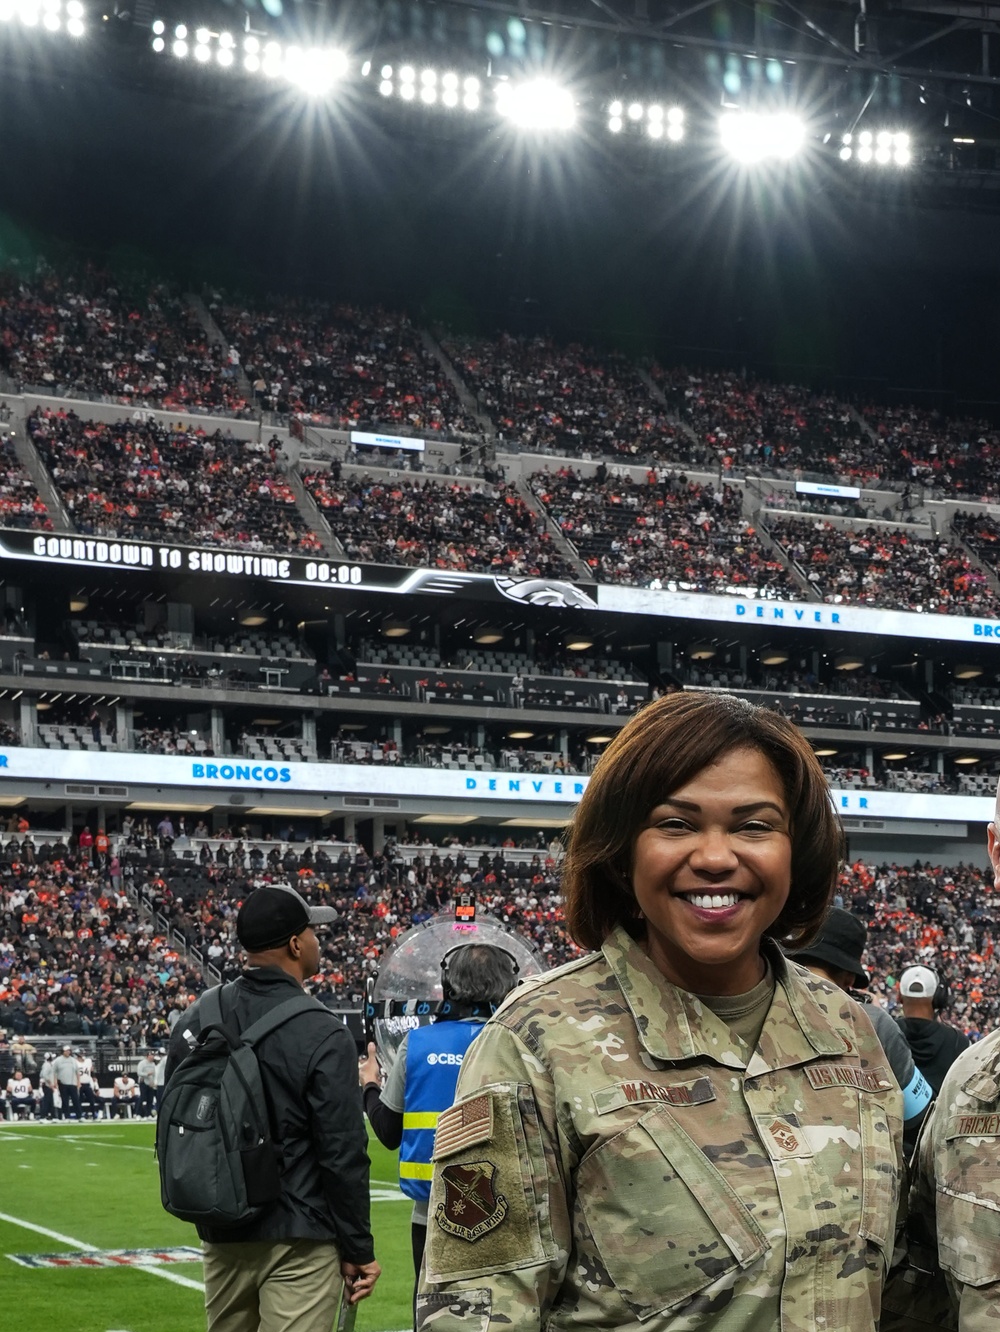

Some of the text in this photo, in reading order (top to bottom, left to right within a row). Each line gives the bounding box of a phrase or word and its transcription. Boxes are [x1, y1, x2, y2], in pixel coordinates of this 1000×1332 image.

[33, 536, 362, 584] COUNTDOWN TO SHOWTIME 00:00
[735, 604, 840, 623] DENVER
[192, 763, 292, 783] BRONCOS
[466, 777, 584, 794] DENVER
[437, 1054, 464, 1066] CBS
[621, 1082, 692, 1104] WARREN
[485, 1209, 504, 1229] WING
